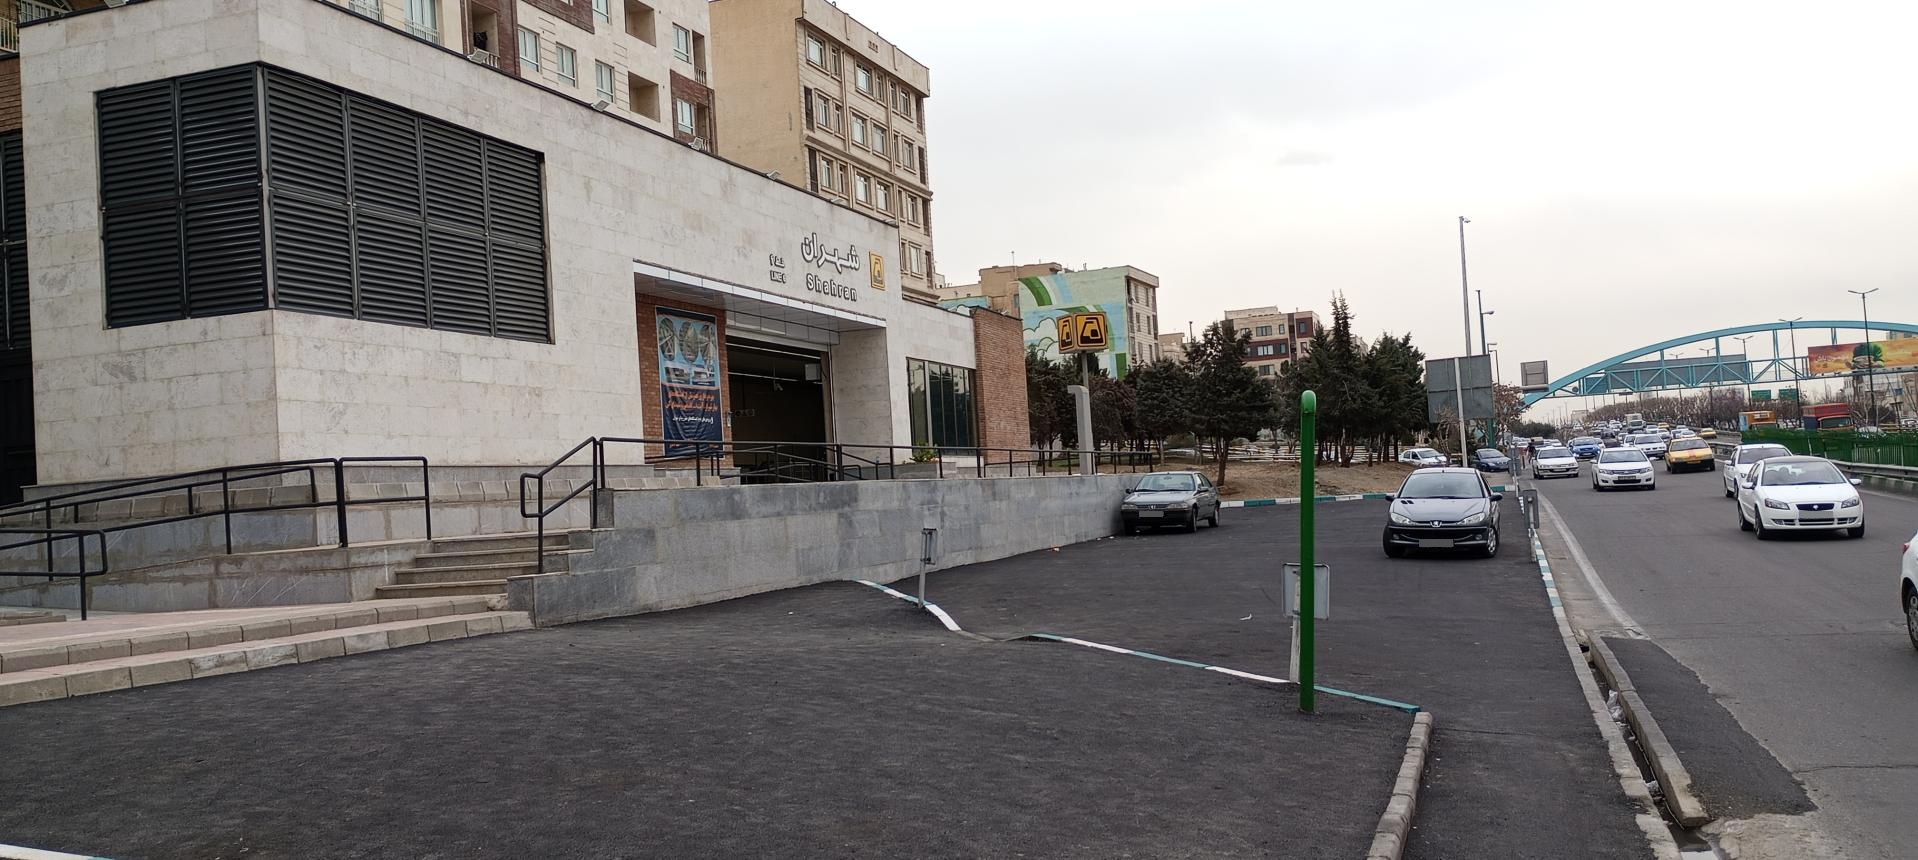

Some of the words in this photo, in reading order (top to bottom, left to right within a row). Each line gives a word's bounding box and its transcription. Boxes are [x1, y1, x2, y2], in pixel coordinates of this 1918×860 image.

[801, 232, 860, 273] شهران
[770, 270, 782, 282] LINE
[806, 273, 857, 301] Shahran
